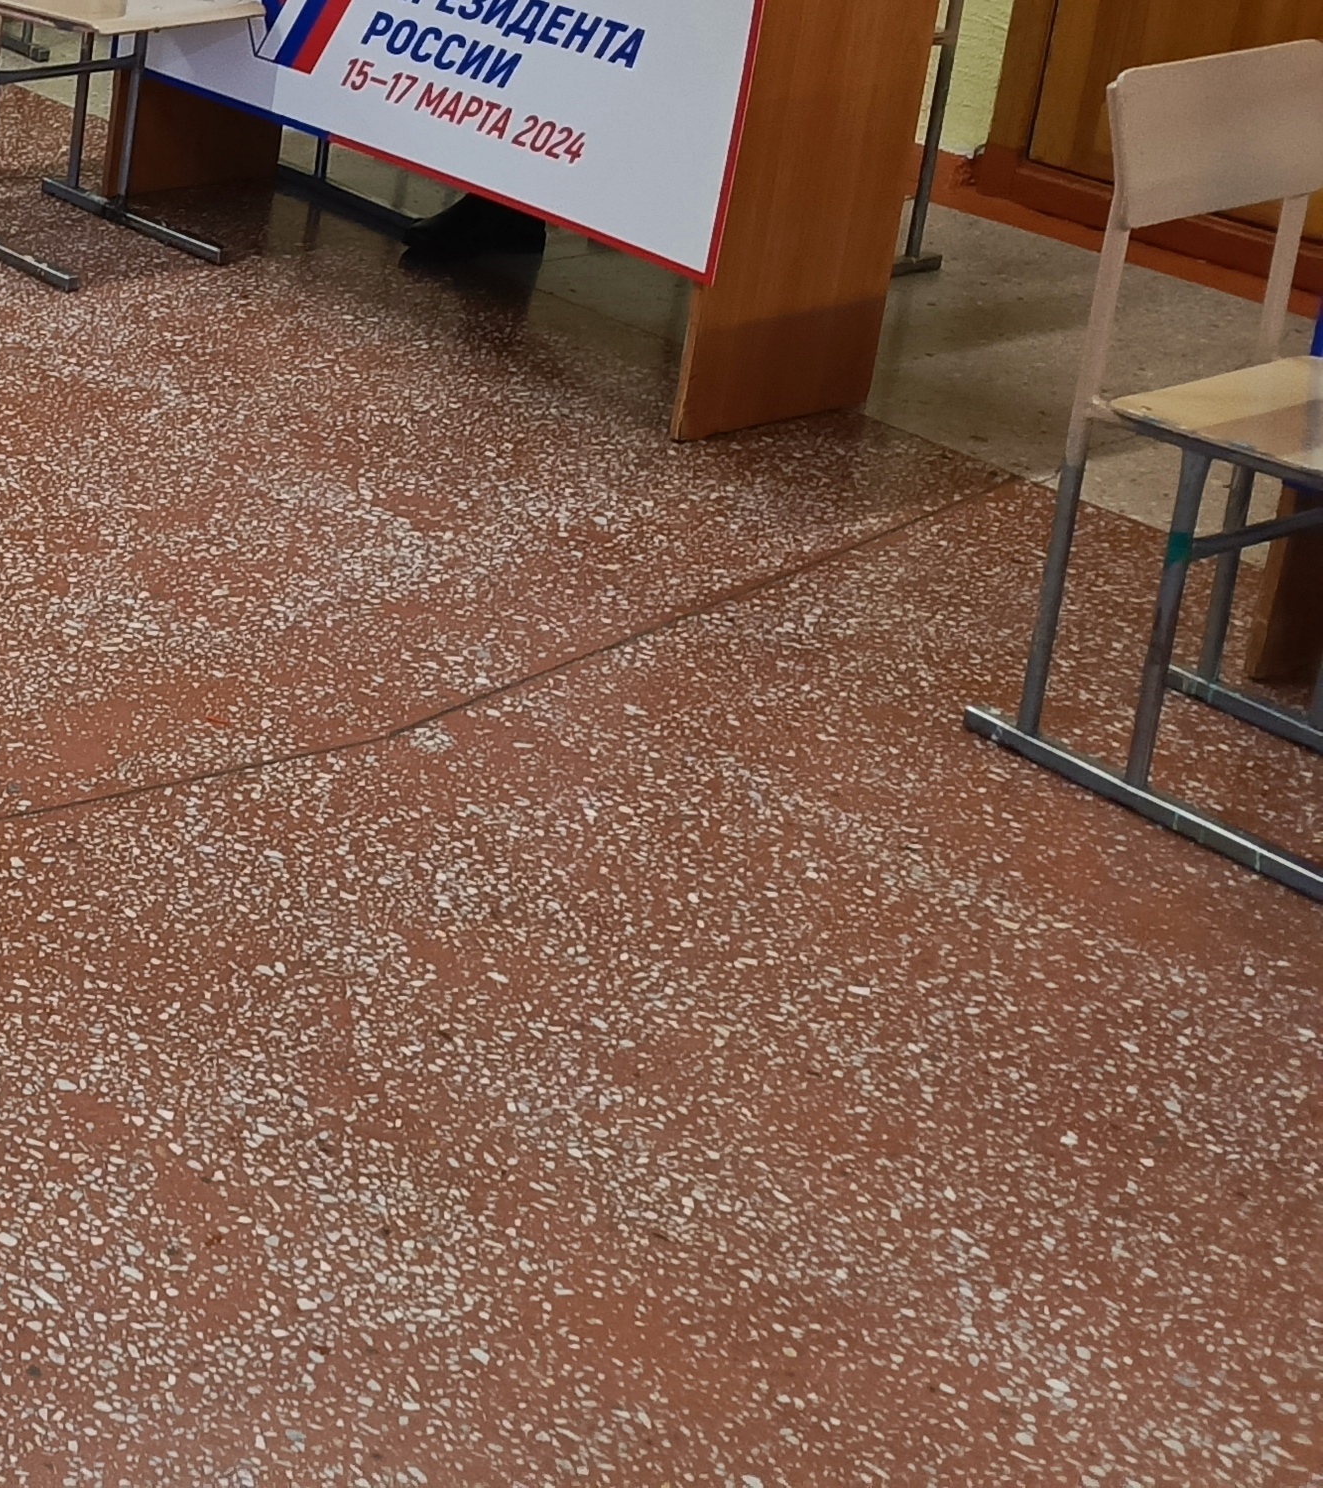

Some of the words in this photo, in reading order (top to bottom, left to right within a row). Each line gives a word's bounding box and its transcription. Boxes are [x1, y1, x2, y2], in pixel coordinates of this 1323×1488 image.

[361, 12, 523, 90] РОССИИ
[414, 81, 511, 141] МАРТА
[512, 114, 587, 165] 2024
